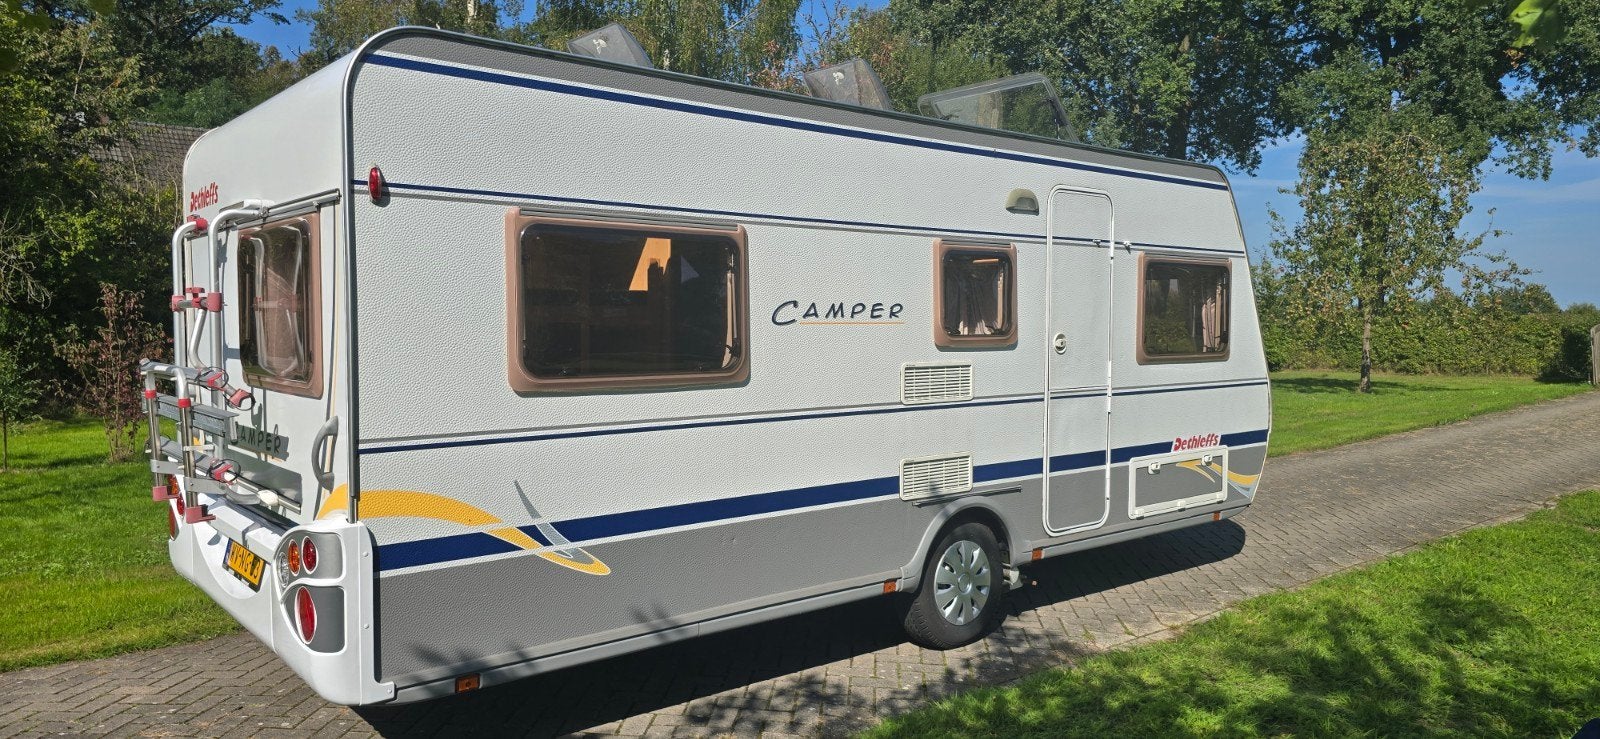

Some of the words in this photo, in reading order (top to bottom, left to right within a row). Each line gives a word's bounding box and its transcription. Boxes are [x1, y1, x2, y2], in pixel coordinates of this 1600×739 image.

[190, 181, 219, 212] Dethleffs
[771, 300, 904, 326] CAMPER
[1173, 433, 1219, 451] Dethleffs
